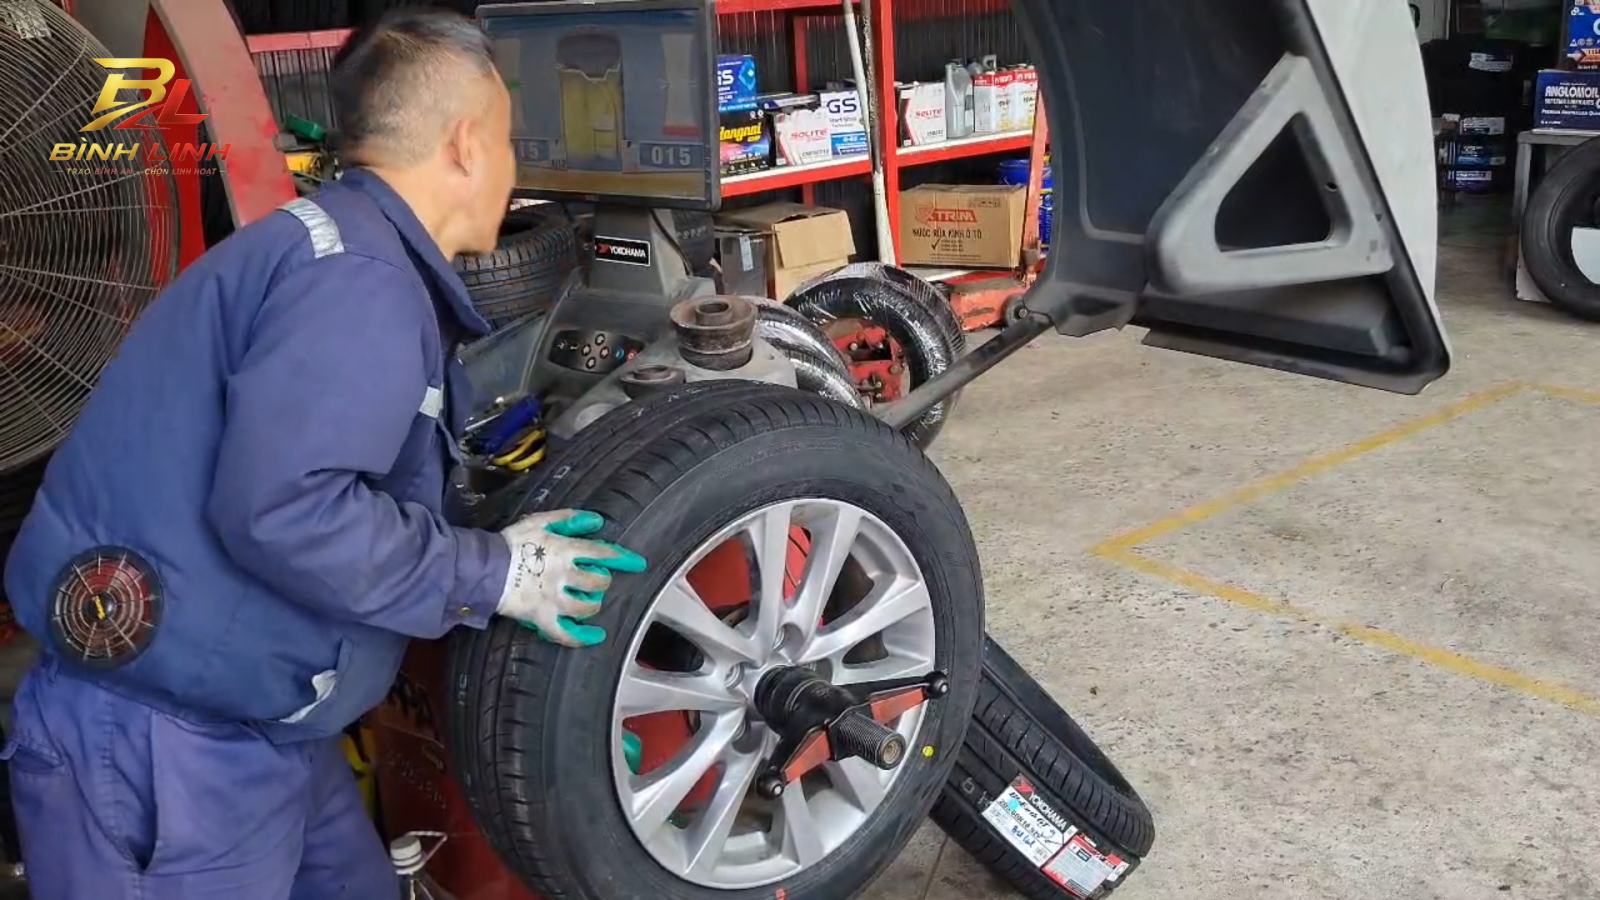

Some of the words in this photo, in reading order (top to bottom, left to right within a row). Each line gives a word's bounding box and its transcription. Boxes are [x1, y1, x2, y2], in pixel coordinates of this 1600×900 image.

[1545, 86, 1599, 98] ANGLOMOIL
[827, 98, 857, 114] GS
[652, 146, 691, 166] 015
[609, 245, 646, 258] YOKOHAMA
[1029, 791, 1067, 830] YOKOHAMA
